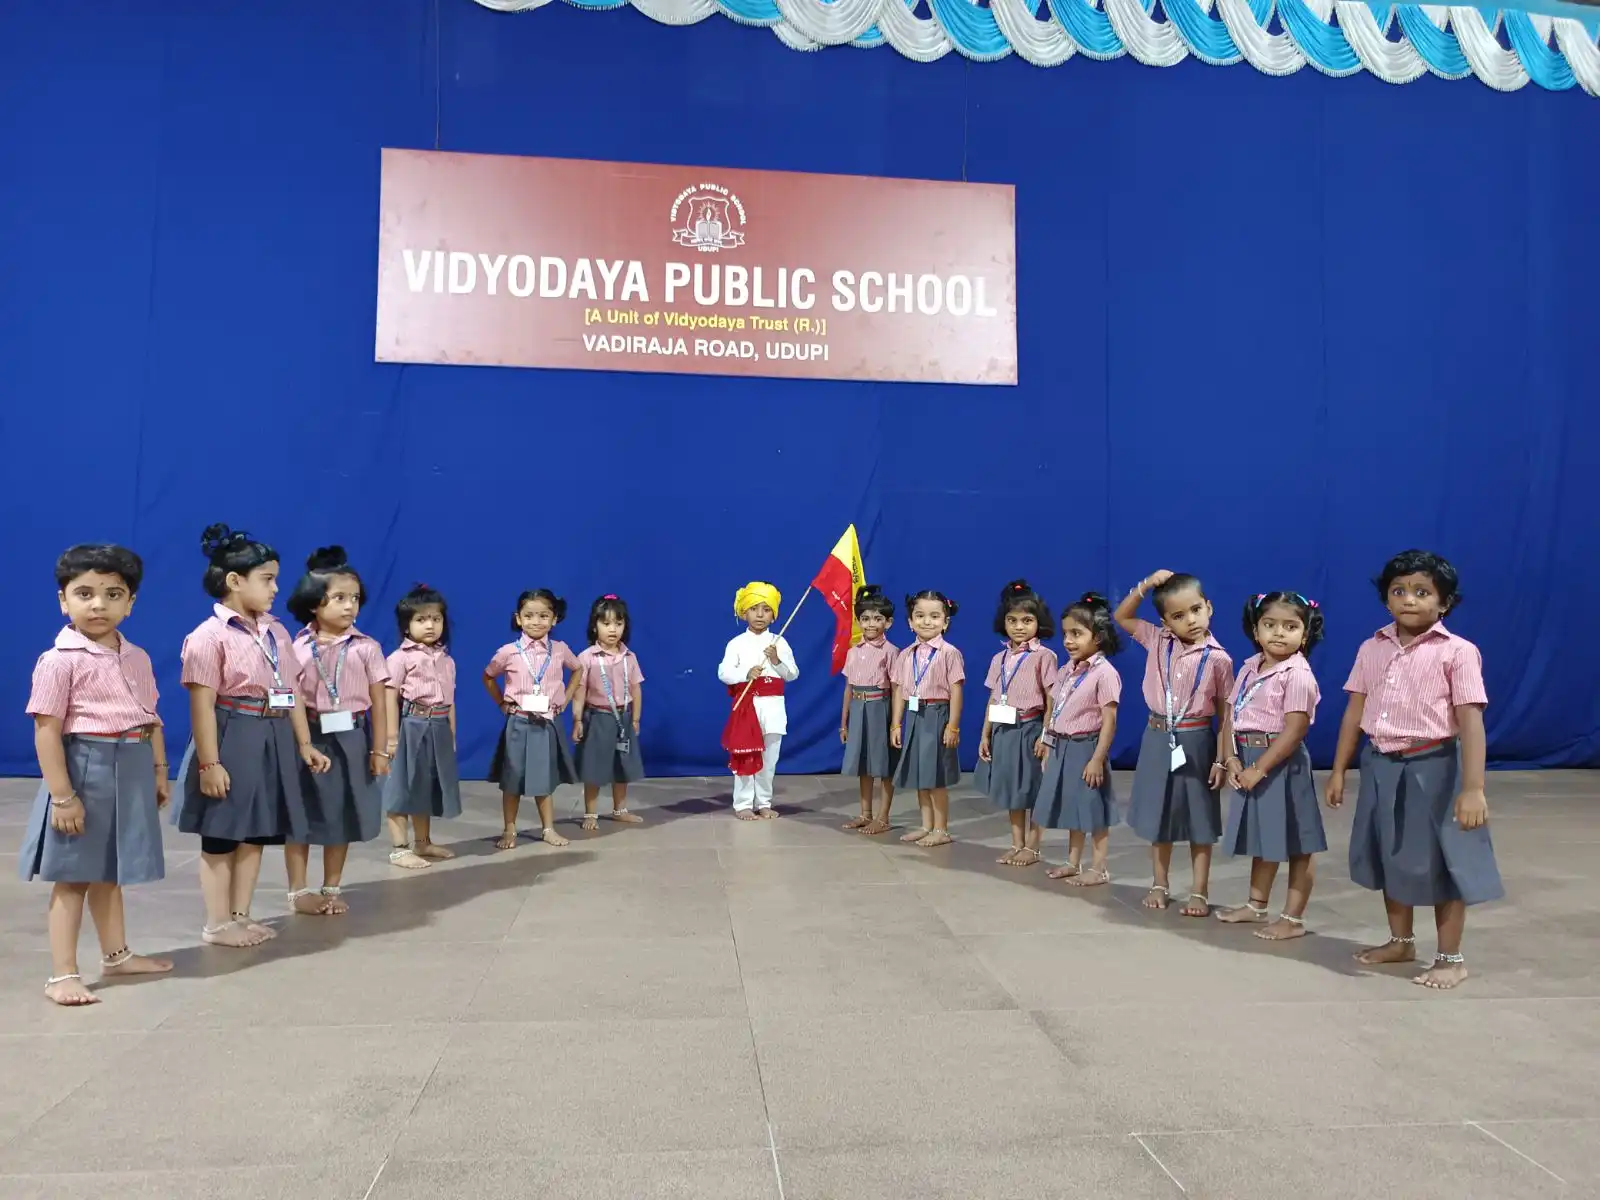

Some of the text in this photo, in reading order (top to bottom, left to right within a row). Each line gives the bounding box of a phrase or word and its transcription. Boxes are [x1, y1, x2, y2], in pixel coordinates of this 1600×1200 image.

[700, 183, 729, 196] PUBLIC
[730, 194, 746, 225] SCHOOL
[402, 249, 998, 318] VIDYODAYA PUBLIC SCHOOL
[584, 308, 827, 335] [A Unit of Vidyodaya Trust (R.)]
[582, 334, 829, 361] VADIRAJA ROAD, UDUPI
